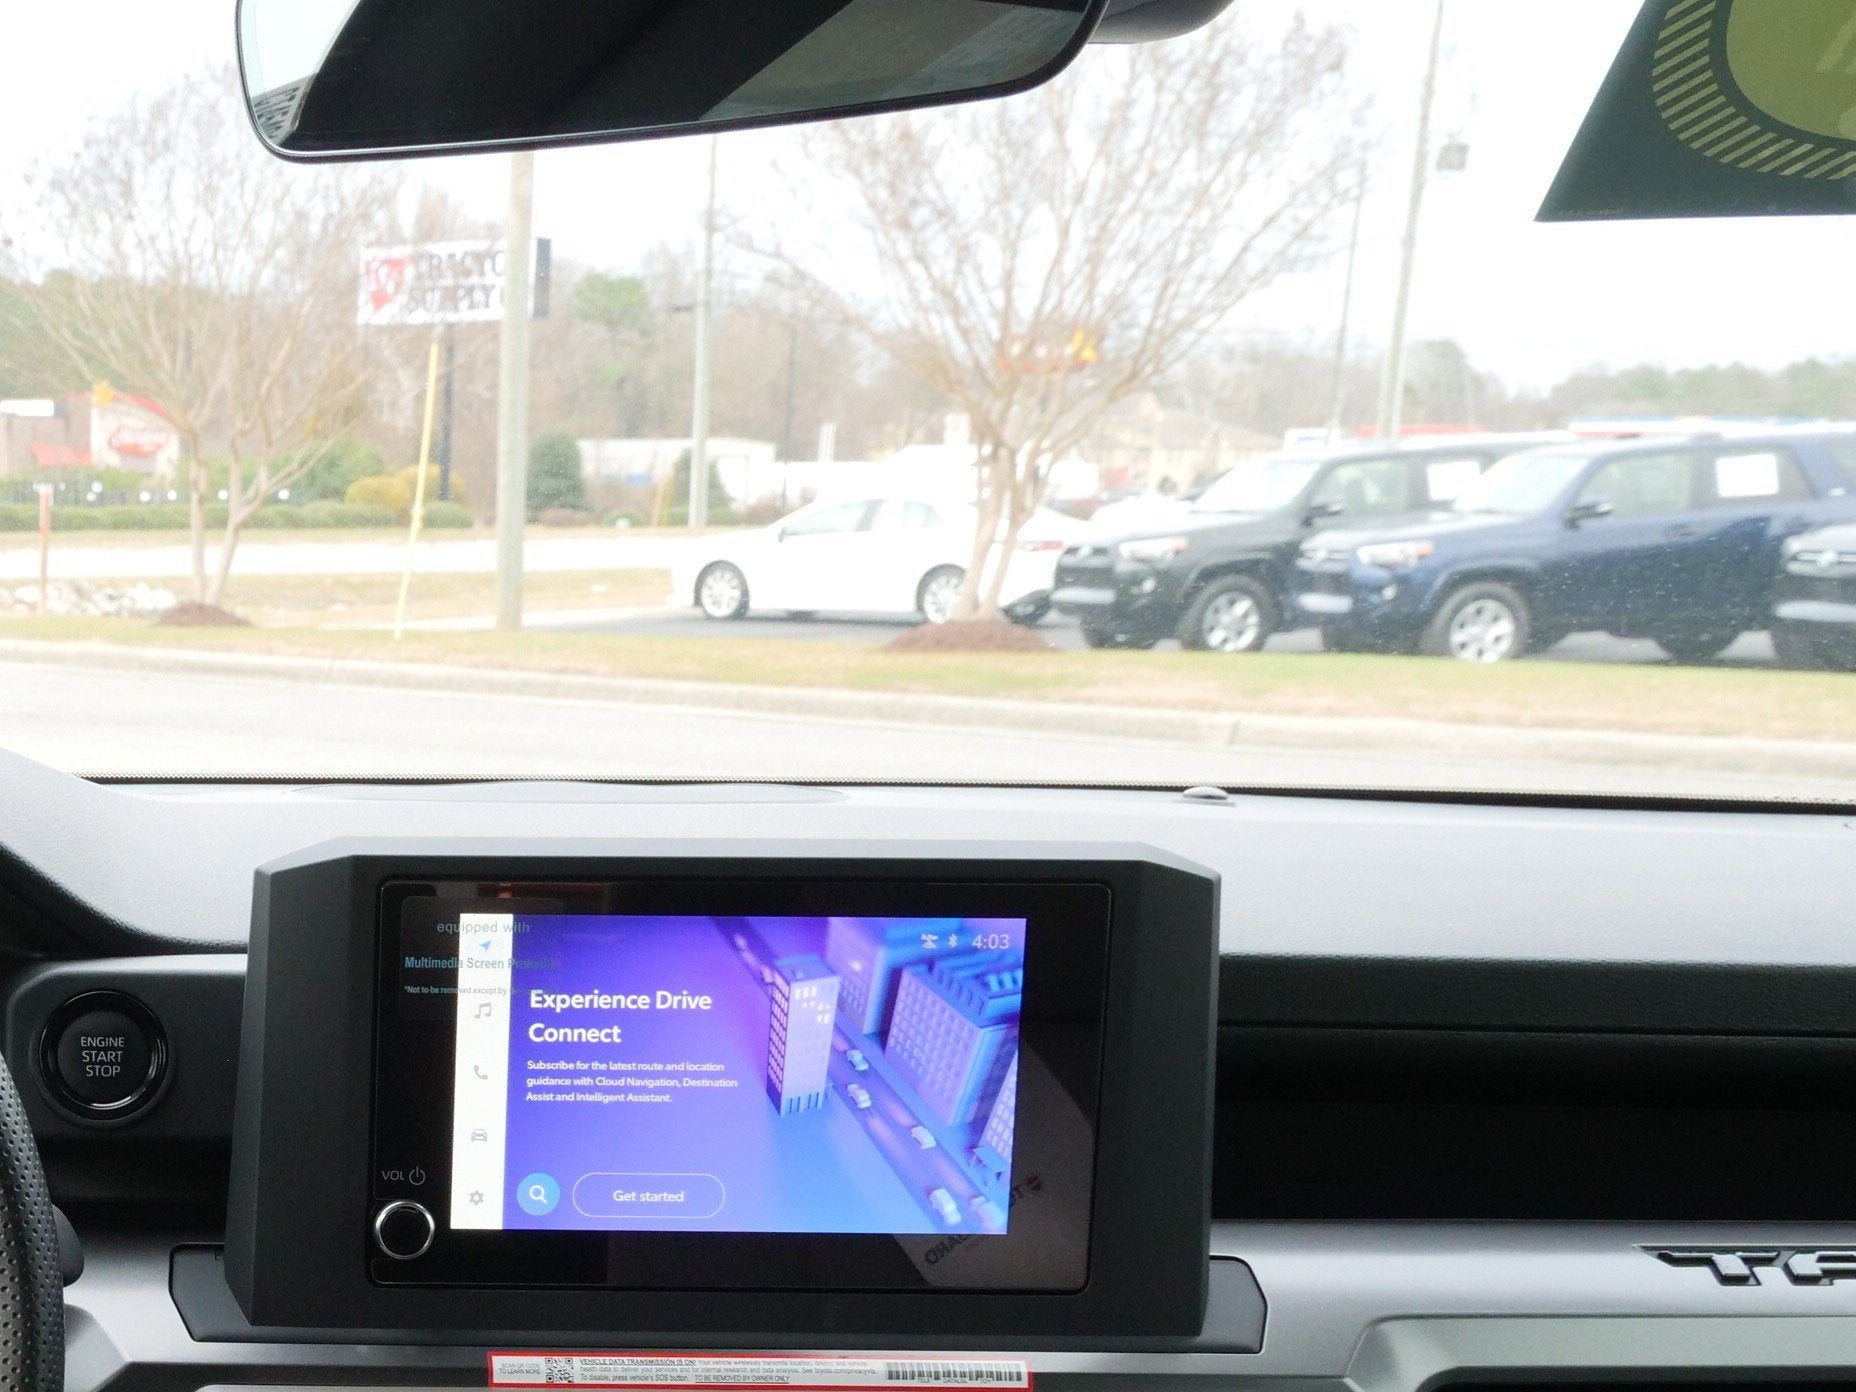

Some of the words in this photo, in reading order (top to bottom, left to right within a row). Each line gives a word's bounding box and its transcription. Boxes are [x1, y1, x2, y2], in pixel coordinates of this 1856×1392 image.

[437, 922, 498, 935] equipped
[503, 922, 530, 933] with
[972, 934, 1010, 949] 4:03
[404, 957, 463, 969] Multimedia
[466, 958, 505, 969] Screen
[530, 989, 650, 1013] Experience
[656, 990, 712, 1010] Drive
[528, 1023, 621, 1042] Connect
[80, 1036, 125, 1047] ENGINE
[82, 1051, 123, 1063] START
[85, 1065, 121, 1077] STOP
[527, 1060, 575, 1071] Subscribe
[576, 1061, 590, 1071] for
[591, 1061, 608, 1071] the
[609, 1061, 636, 1071] latest
[638, 1063, 663, 1071] route
[665, 1062, 685, 1071] and
[686, 1062, 724, 1071] location
[526, 1076, 571, 1088] guidance
[573, 1077, 593, 1086] with
[595, 1077, 625, 1086] Cloud
[626, 1077, 681, 1089] Navigation,
[683, 1078, 738, 1088] Destination
[526, 1092, 555, 1102] Assist
[555, 1092, 575, 1102] and
[576, 1093, 625, 1104] Intelligent
[626, 1093, 672, 1103] Assistant.
[381, 1170, 405, 1181] VOL
[612, 1190, 637, 1202] Get
[640, 1190, 684, 1203] started
